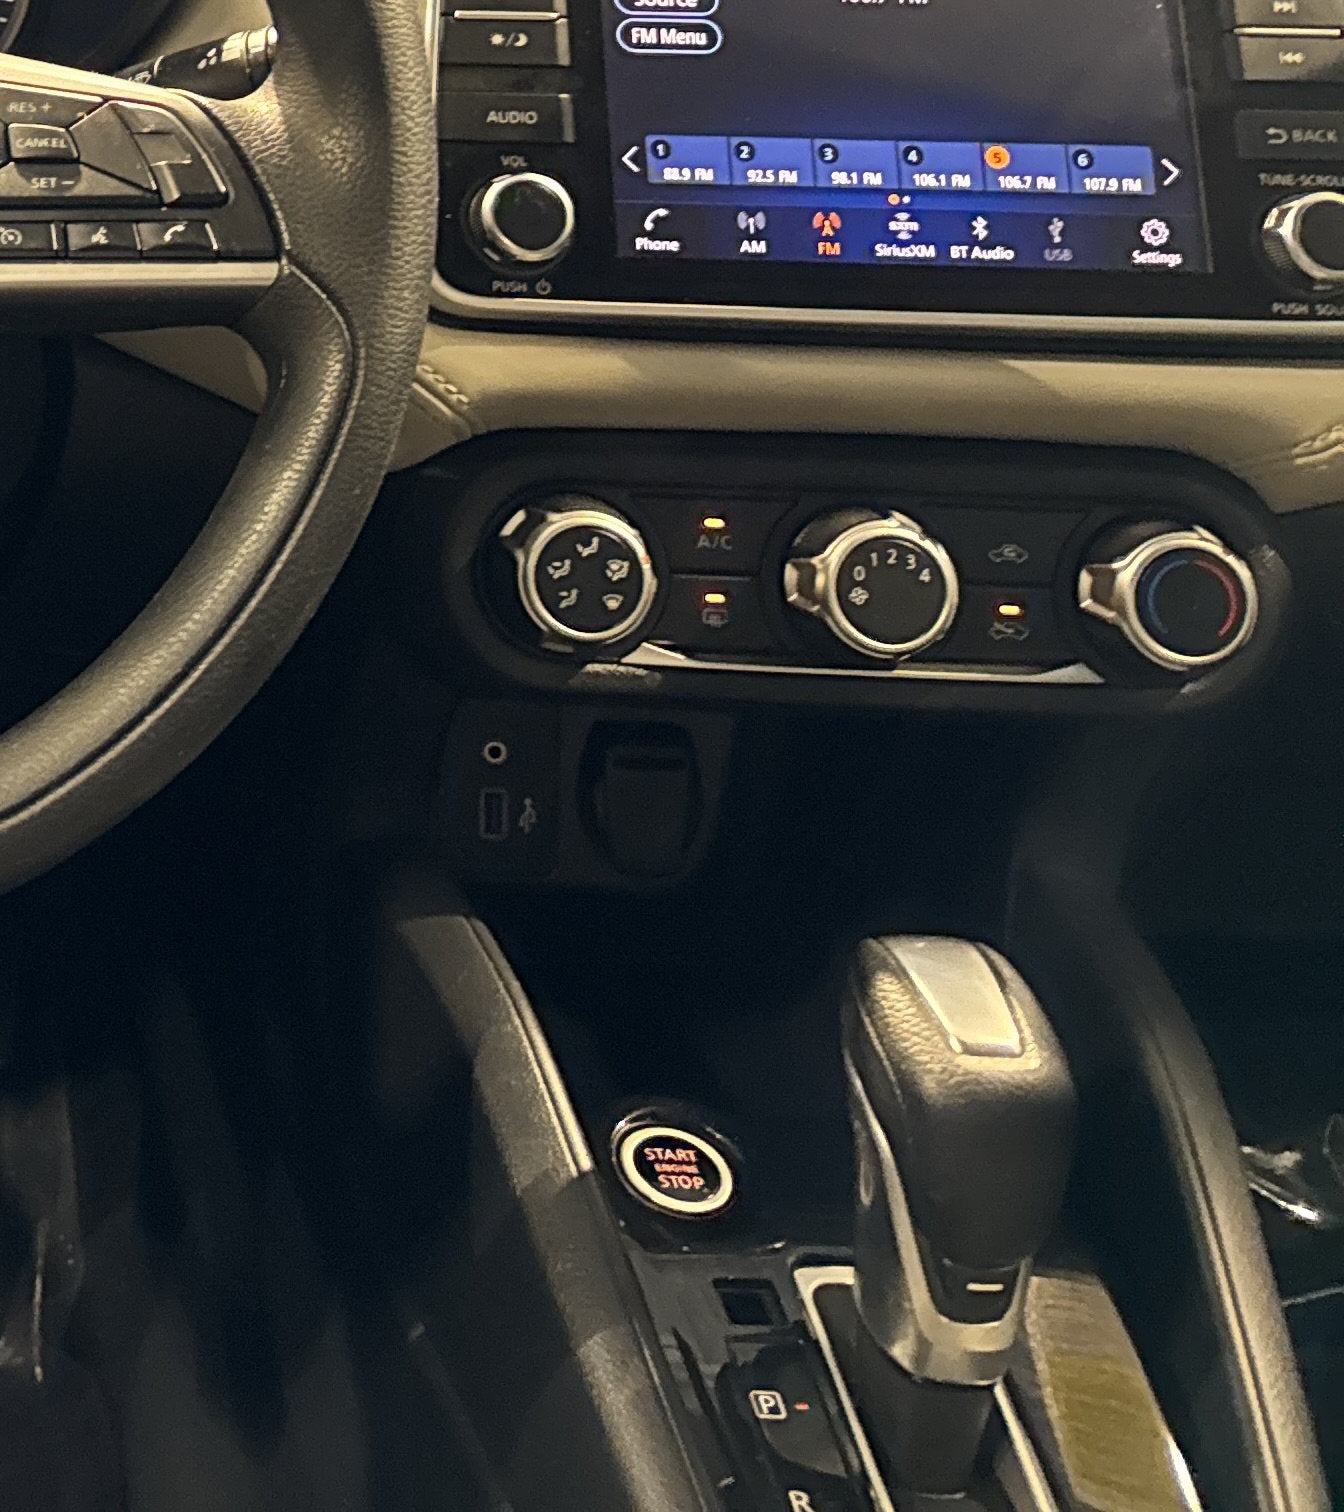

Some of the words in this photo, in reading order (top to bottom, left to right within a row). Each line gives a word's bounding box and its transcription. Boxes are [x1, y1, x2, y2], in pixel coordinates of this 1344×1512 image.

[631, 27, 658, 45] FM
[660, 29, 708, 45] Menu
[7, 101, 37, 113] RES
[486, 110, 538, 124] AUDIO
[16, 137, 67, 149] CANCEL
[1291, 128, 1338, 144] BACK
[656, 144, 666, 156] 1
[740, 145, 750, 158] 2
[823, 147, 834, 160] 3
[906, 150, 919, 163] 4
[500, 155, 528, 167] VOL
[993, 152, 1002, 164] 5
[1077, 153, 1089, 167] 6
[694, 168, 714, 181] FM
[747, 170, 774, 183] 92.5
[778, 170, 798, 183] FM
[831, 172, 858, 185] 98.1
[863, 172, 882, 185] FM
[913, 174, 946, 187] 106.1
[951, 174, 971, 188] FM
[31, 177, 58, 189] SET
[998, 175, 1032, 189] 106.7
[1036, 176, 1056, 189] FM
[1083, 178, 1118, 191] 107.9
[1122, 178, 1142, 192] FM
[635, 238, 680, 252] Phone
[740, 240, 767, 254] AM
[817, 242, 841, 256] FM
[874, 244, 936, 258] SiriusXM
[950, 245, 969, 259] BT
[971, 245, 1015, 260] Audio
[1044, 248, 1073, 261] USB
[1131, 250, 1183, 267] Settings
[492, 280, 528, 293] PUSH
[697, 534, 733, 550] A/C
[870, 551, 879, 567] 1
[886, 548, 898, 565] 2
[905, 553, 917, 570] 3
[853, 565, 866, 581] 0
[918, 568, 932, 583] 4
[643, 1148, 698, 1163] START
[658, 1175, 705, 1189] STOP
[758, 1394, 776, 1415] P
[788, 1489, 815, 1512] R
